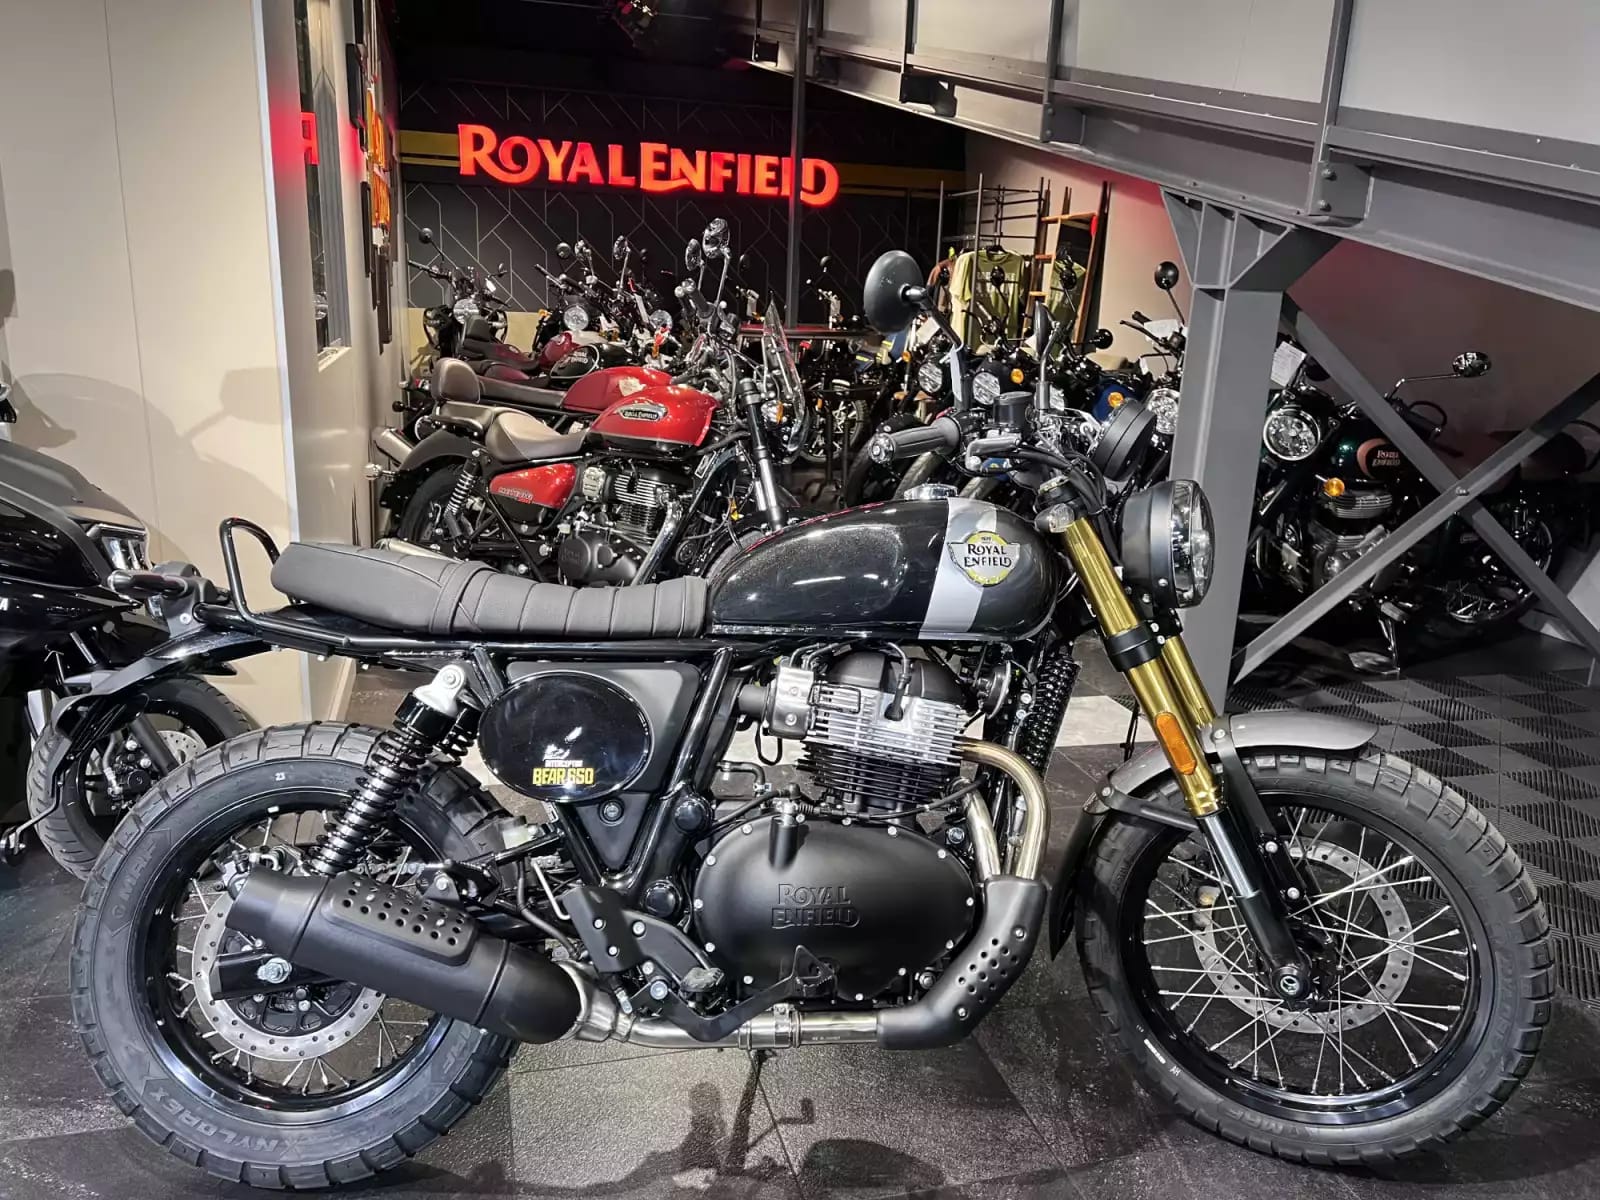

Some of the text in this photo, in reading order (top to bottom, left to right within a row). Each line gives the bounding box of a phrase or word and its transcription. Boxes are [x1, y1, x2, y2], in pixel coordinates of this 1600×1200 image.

[457, 123, 636, 185] ROYAL
[967, 543, 1007, 556] ROYAL
[963, 556, 1012, 568] ENFIELD
[532, 767, 594, 785] BEAR 650
[778, 883, 851, 907] ROYAL
[771, 907, 861, 930] ENFIELD
[150, 1087, 279, 1152] NYLOREX
